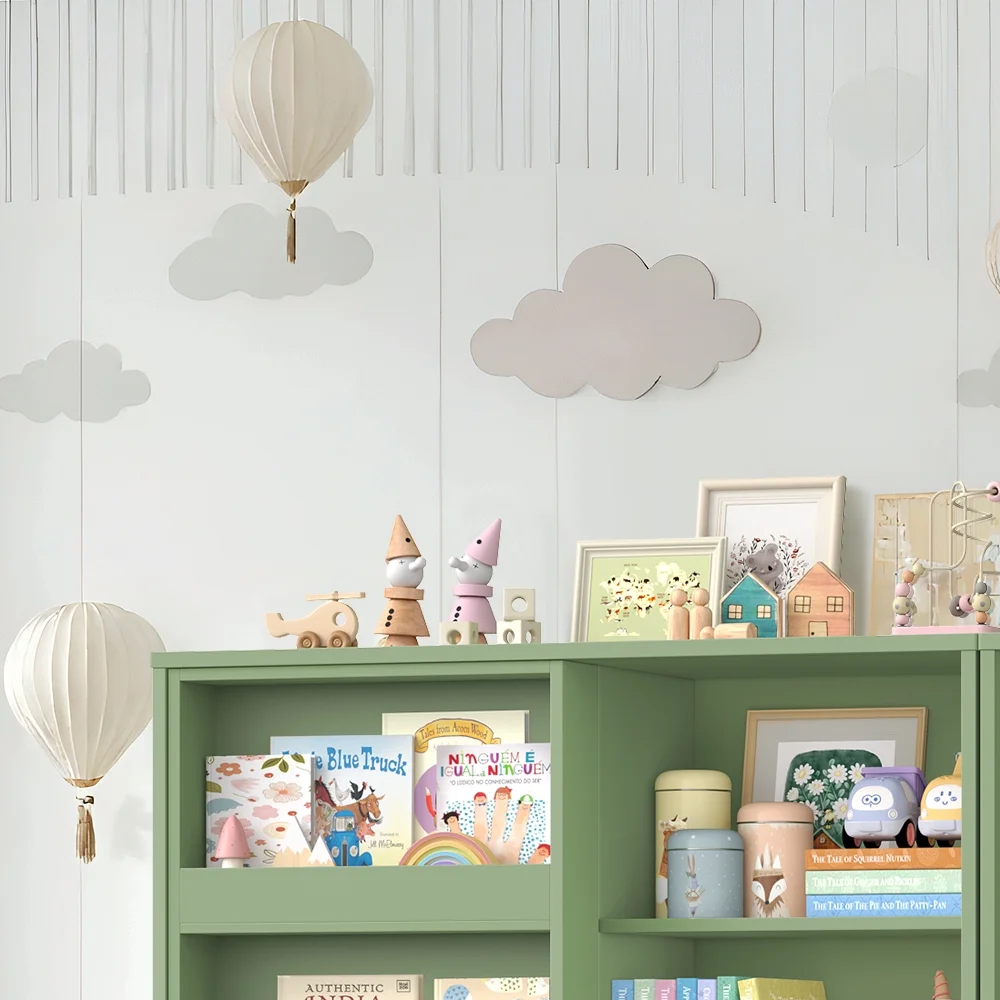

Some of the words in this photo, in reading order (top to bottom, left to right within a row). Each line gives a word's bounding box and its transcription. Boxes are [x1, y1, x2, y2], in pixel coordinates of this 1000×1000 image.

[420, 727, 435, 740] Tales
[436, 723, 450, 734] from
[451, 722, 470, 734] Acorn
[470, 723, 489, 740] Wood
[327, 747, 359, 771] Blue
[361, 746, 407, 776] Truck
[525, 749, 535, 763] É
[440, 765, 479, 777] IGUAL
[812, 854, 826, 864] THE
[827, 854, 843, 864] TALE
[844, 855, 852, 863] OF
[854, 854, 885, 864] SQUIRREL
[813, 901, 826, 911] THE
[828, 901, 844, 911] TALE
[845, 901, 853, 910] OF
[854, 900, 868, 910] THE
[869, 900, 879, 910] PIE
[881, 902, 894, 910] AND
[895, 900, 908, 910] THE
[910, 900, 947, 910] PATTY-PAN
[304, 984, 384, 993] AUTHENTIC
[722, 984, 732, 1000] THE
